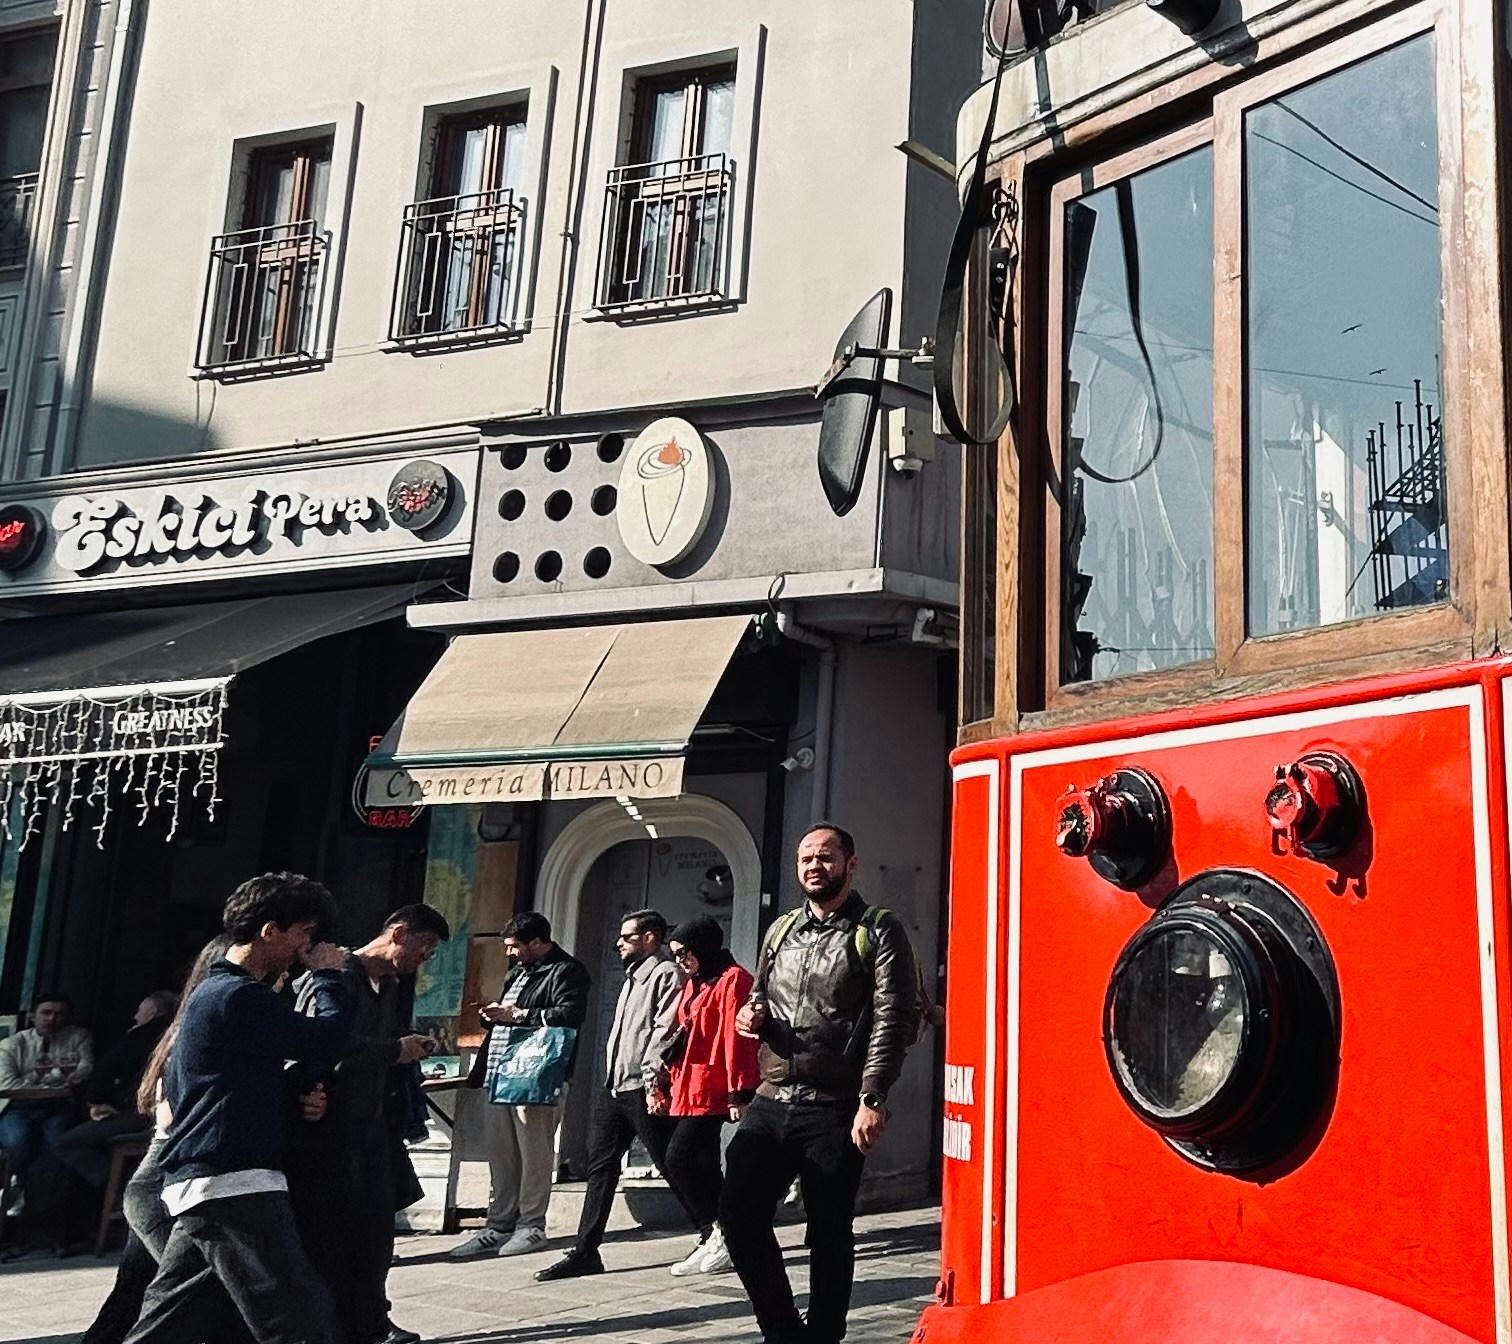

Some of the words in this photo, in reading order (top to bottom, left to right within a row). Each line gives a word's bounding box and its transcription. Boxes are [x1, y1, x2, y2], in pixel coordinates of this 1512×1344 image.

[264, 480, 373, 544] Pera
[113, 706, 214, 735] GREATNESS
[386, 767, 524, 799] Cremeria
